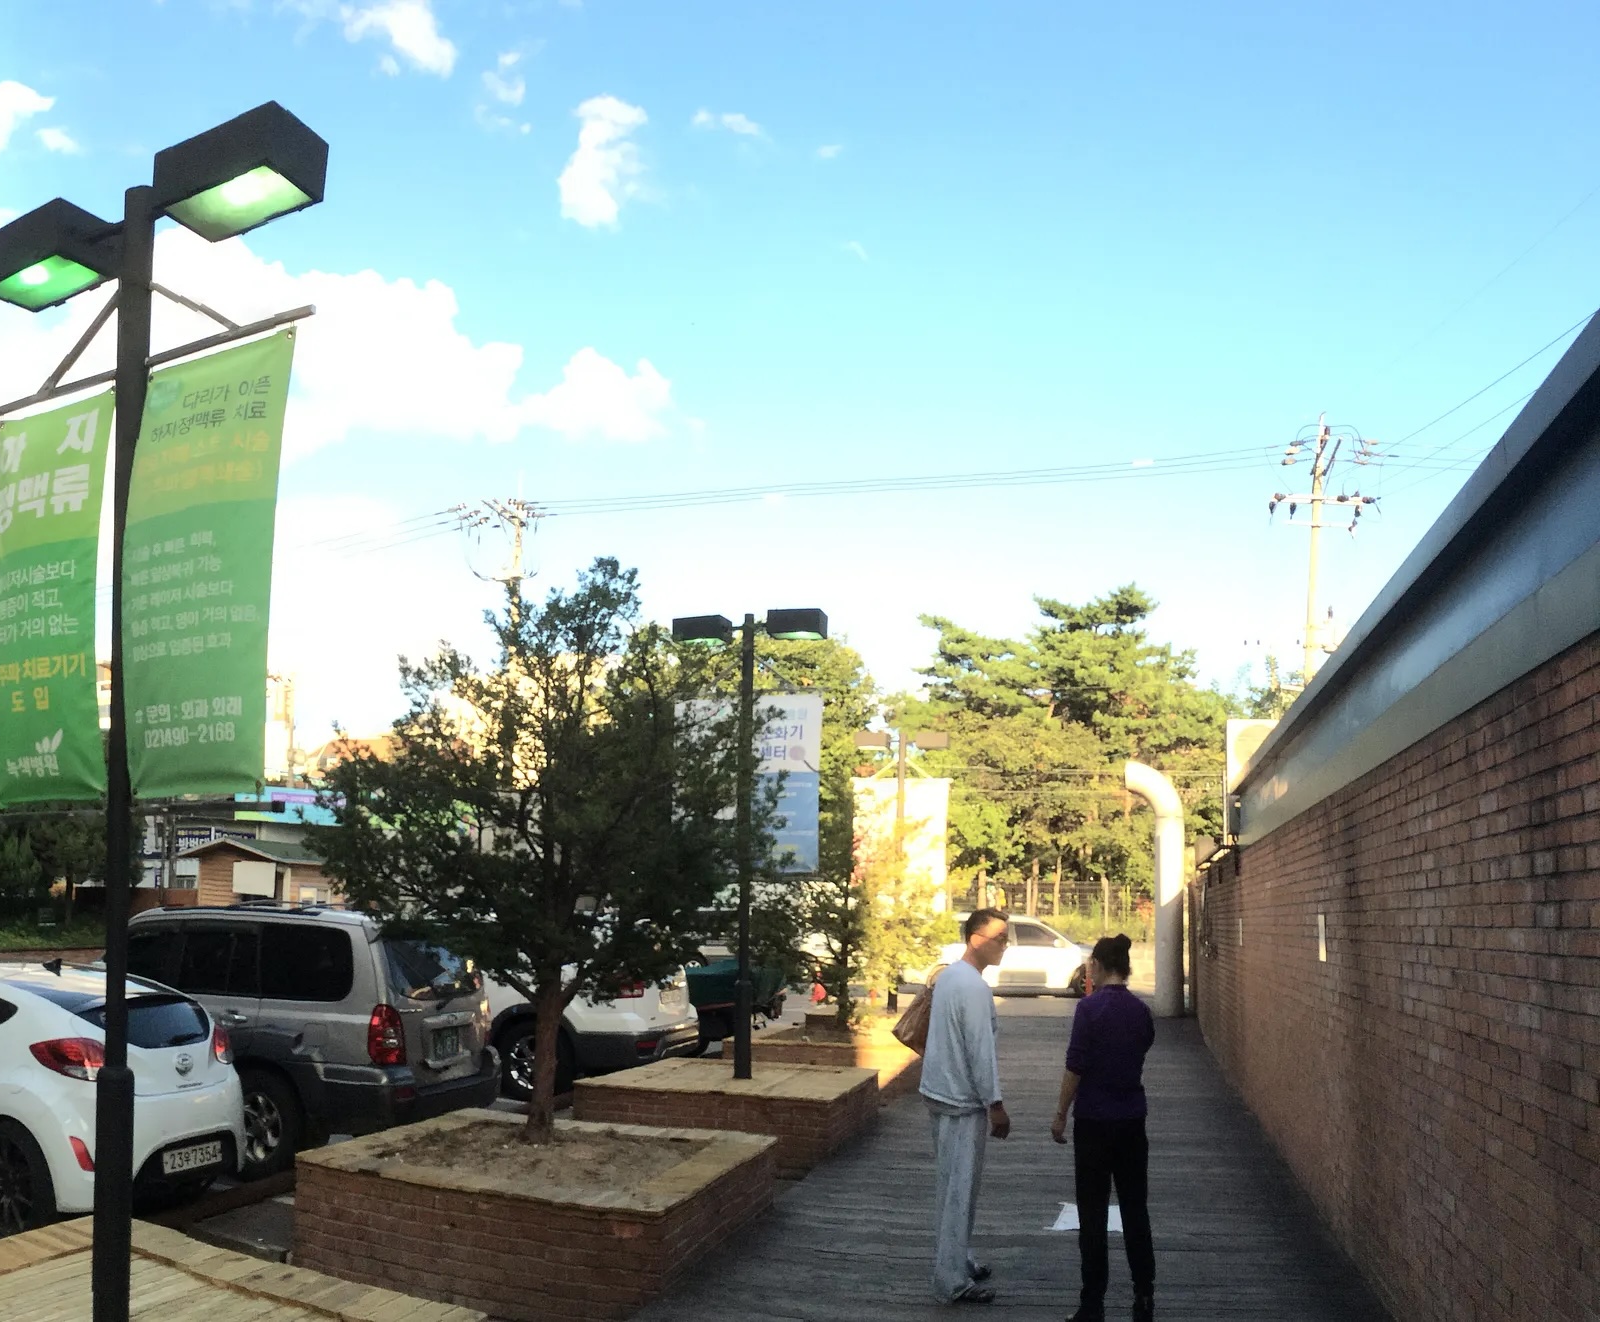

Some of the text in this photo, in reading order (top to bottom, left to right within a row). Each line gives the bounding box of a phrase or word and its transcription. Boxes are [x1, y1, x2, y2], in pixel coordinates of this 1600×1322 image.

[182, 384, 230, 410] 다리가
[151, 400, 268, 444] 하지정맥류 치료
[20, 616, 45, 640] 거의
[48, 613, 79, 636] 없는
[22, 652, 86, 681] 치료기기
